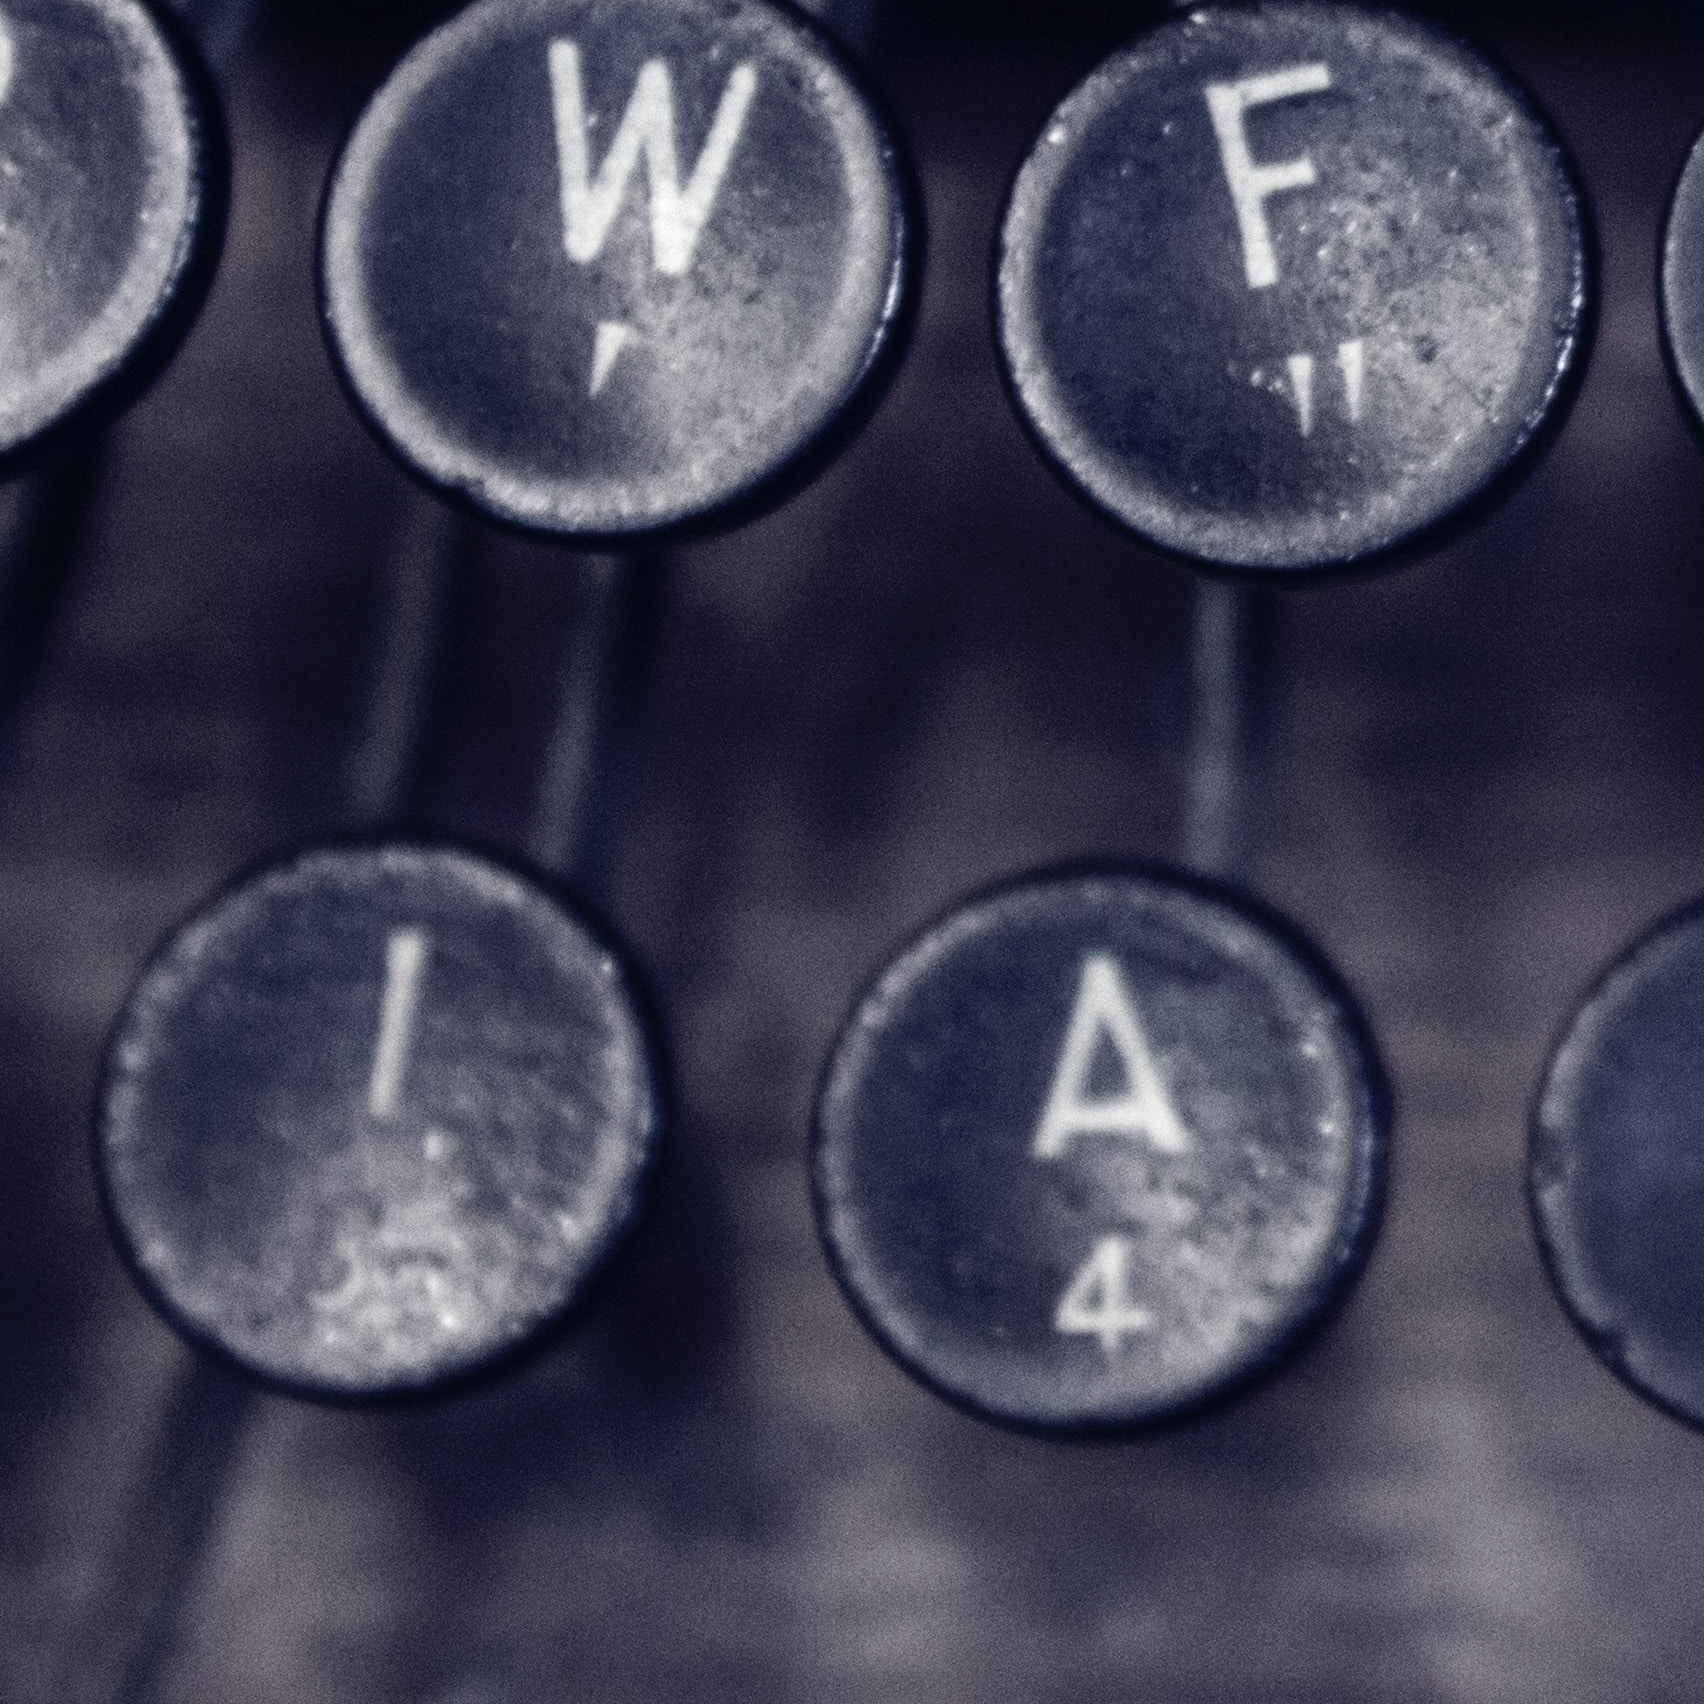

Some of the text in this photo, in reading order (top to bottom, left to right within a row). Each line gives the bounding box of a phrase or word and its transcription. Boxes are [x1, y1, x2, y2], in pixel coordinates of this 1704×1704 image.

[547, 38, 758, 277] W
[1203, 61, 1329, 289] F
[1032, 951, 1190, 1158] A
[1051, 1234, 1152, 1349] 4
